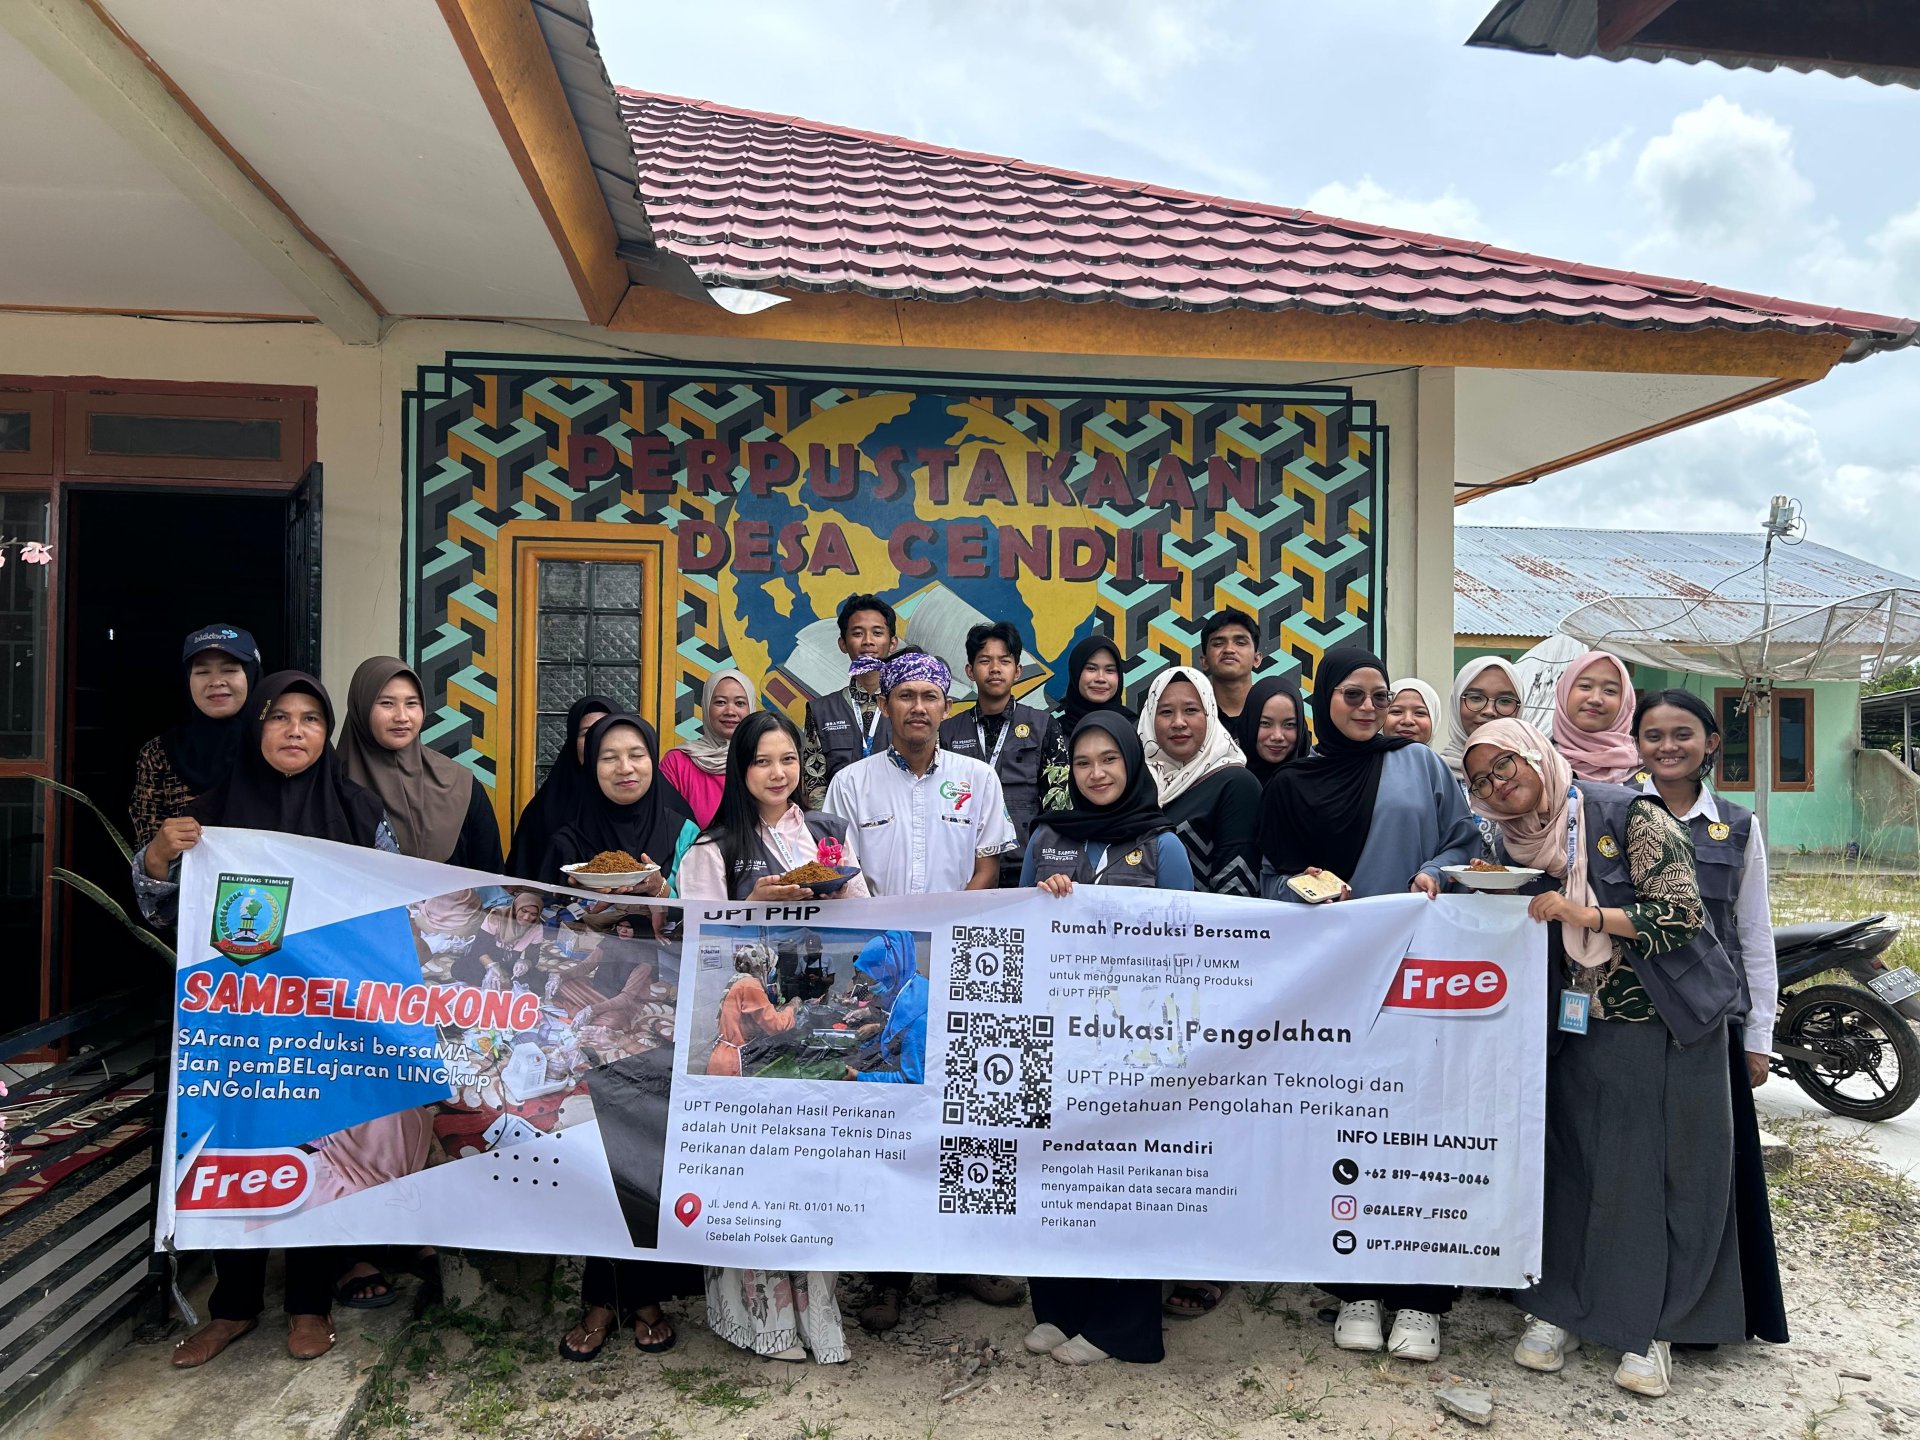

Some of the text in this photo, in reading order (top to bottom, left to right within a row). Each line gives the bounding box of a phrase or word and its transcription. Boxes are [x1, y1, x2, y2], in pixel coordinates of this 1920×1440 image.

[567, 434, 1259, 510] PERPUSTAKAAN
[678, 519, 1181, 583] DESA CENDIL
[221, 875, 262, 883] BELITUNG
[704, 906, 820, 921] UPT PHP
[1052, 920, 1270, 939] Rumah Produksi Bersama
[1051, 954, 1072, 963] UPT
[1076, 955, 1097, 964] PHP
[1100, 955, 1171, 968] Memfasilitasi
[1174, 958, 1193, 968] UPI
[1204, 959, 1239, 968] UMKM
[1050, 971, 1252, 986] untuk menggunakan Ruang Produksi
[1402, 968, 1499, 1000] Free
[1049, 986, 1110, 998] di UPT PHP
[181, 971, 540, 1031] SAMBELINGKONG
[1068, 1014, 1351, 1049] Edukasi Pengolahan
[178, 1028, 470, 1063] SArana produksi bersaMA
[178, 1052, 491, 1094] dan pemBELajaran LINGkup
[1068, 1070, 1403, 1093] UPT PHP menyebarkan Teknologi dan
[685, 1101, 895, 1118] UPT Pengolahan Hasil Perikanan
[1067, 1097, 1388, 1118] Pengetahuan Pengolahan Perikanan
[682, 1121, 911, 1140] adalah Unit Pelaksana Teknis Dinas
[1043, 1140, 1212, 1154] Pendataan Mandiri
[1338, 1130, 1498, 1150] INFO LEBIH LANJUT
[681, 1142, 905, 1160] Perikanan dalam Pengolahan Hasil
[679, 1163, 743, 1175] Perikanan
[1042, 1164, 1208, 1177] Pengolah Hasil Perikanan bisa
[1365, 1169, 1489, 1185] +62 819-4943-0046
[190, 1163, 298, 1202] Free
[1042, 1183, 1236, 1195] menyampaikan data secara mandiri
[708, 1200, 864, 1212] Jl. Jend A. Yani Rt. 01/01 No.11
[1042, 1199, 1207, 1212] untuk mendapat Binaan Dinas
[1364, 1205, 1467, 1219] @GALERY_FISCO
[707, 1216, 781, 1228] Desa Selinsing
[1042, 1217, 1095, 1227] Perikanan
[706, 1231, 833, 1246] (Sebelah Polsek Gantung
[1367, 1239, 1499, 1256] UPT.PHP@GMAIL.COM
